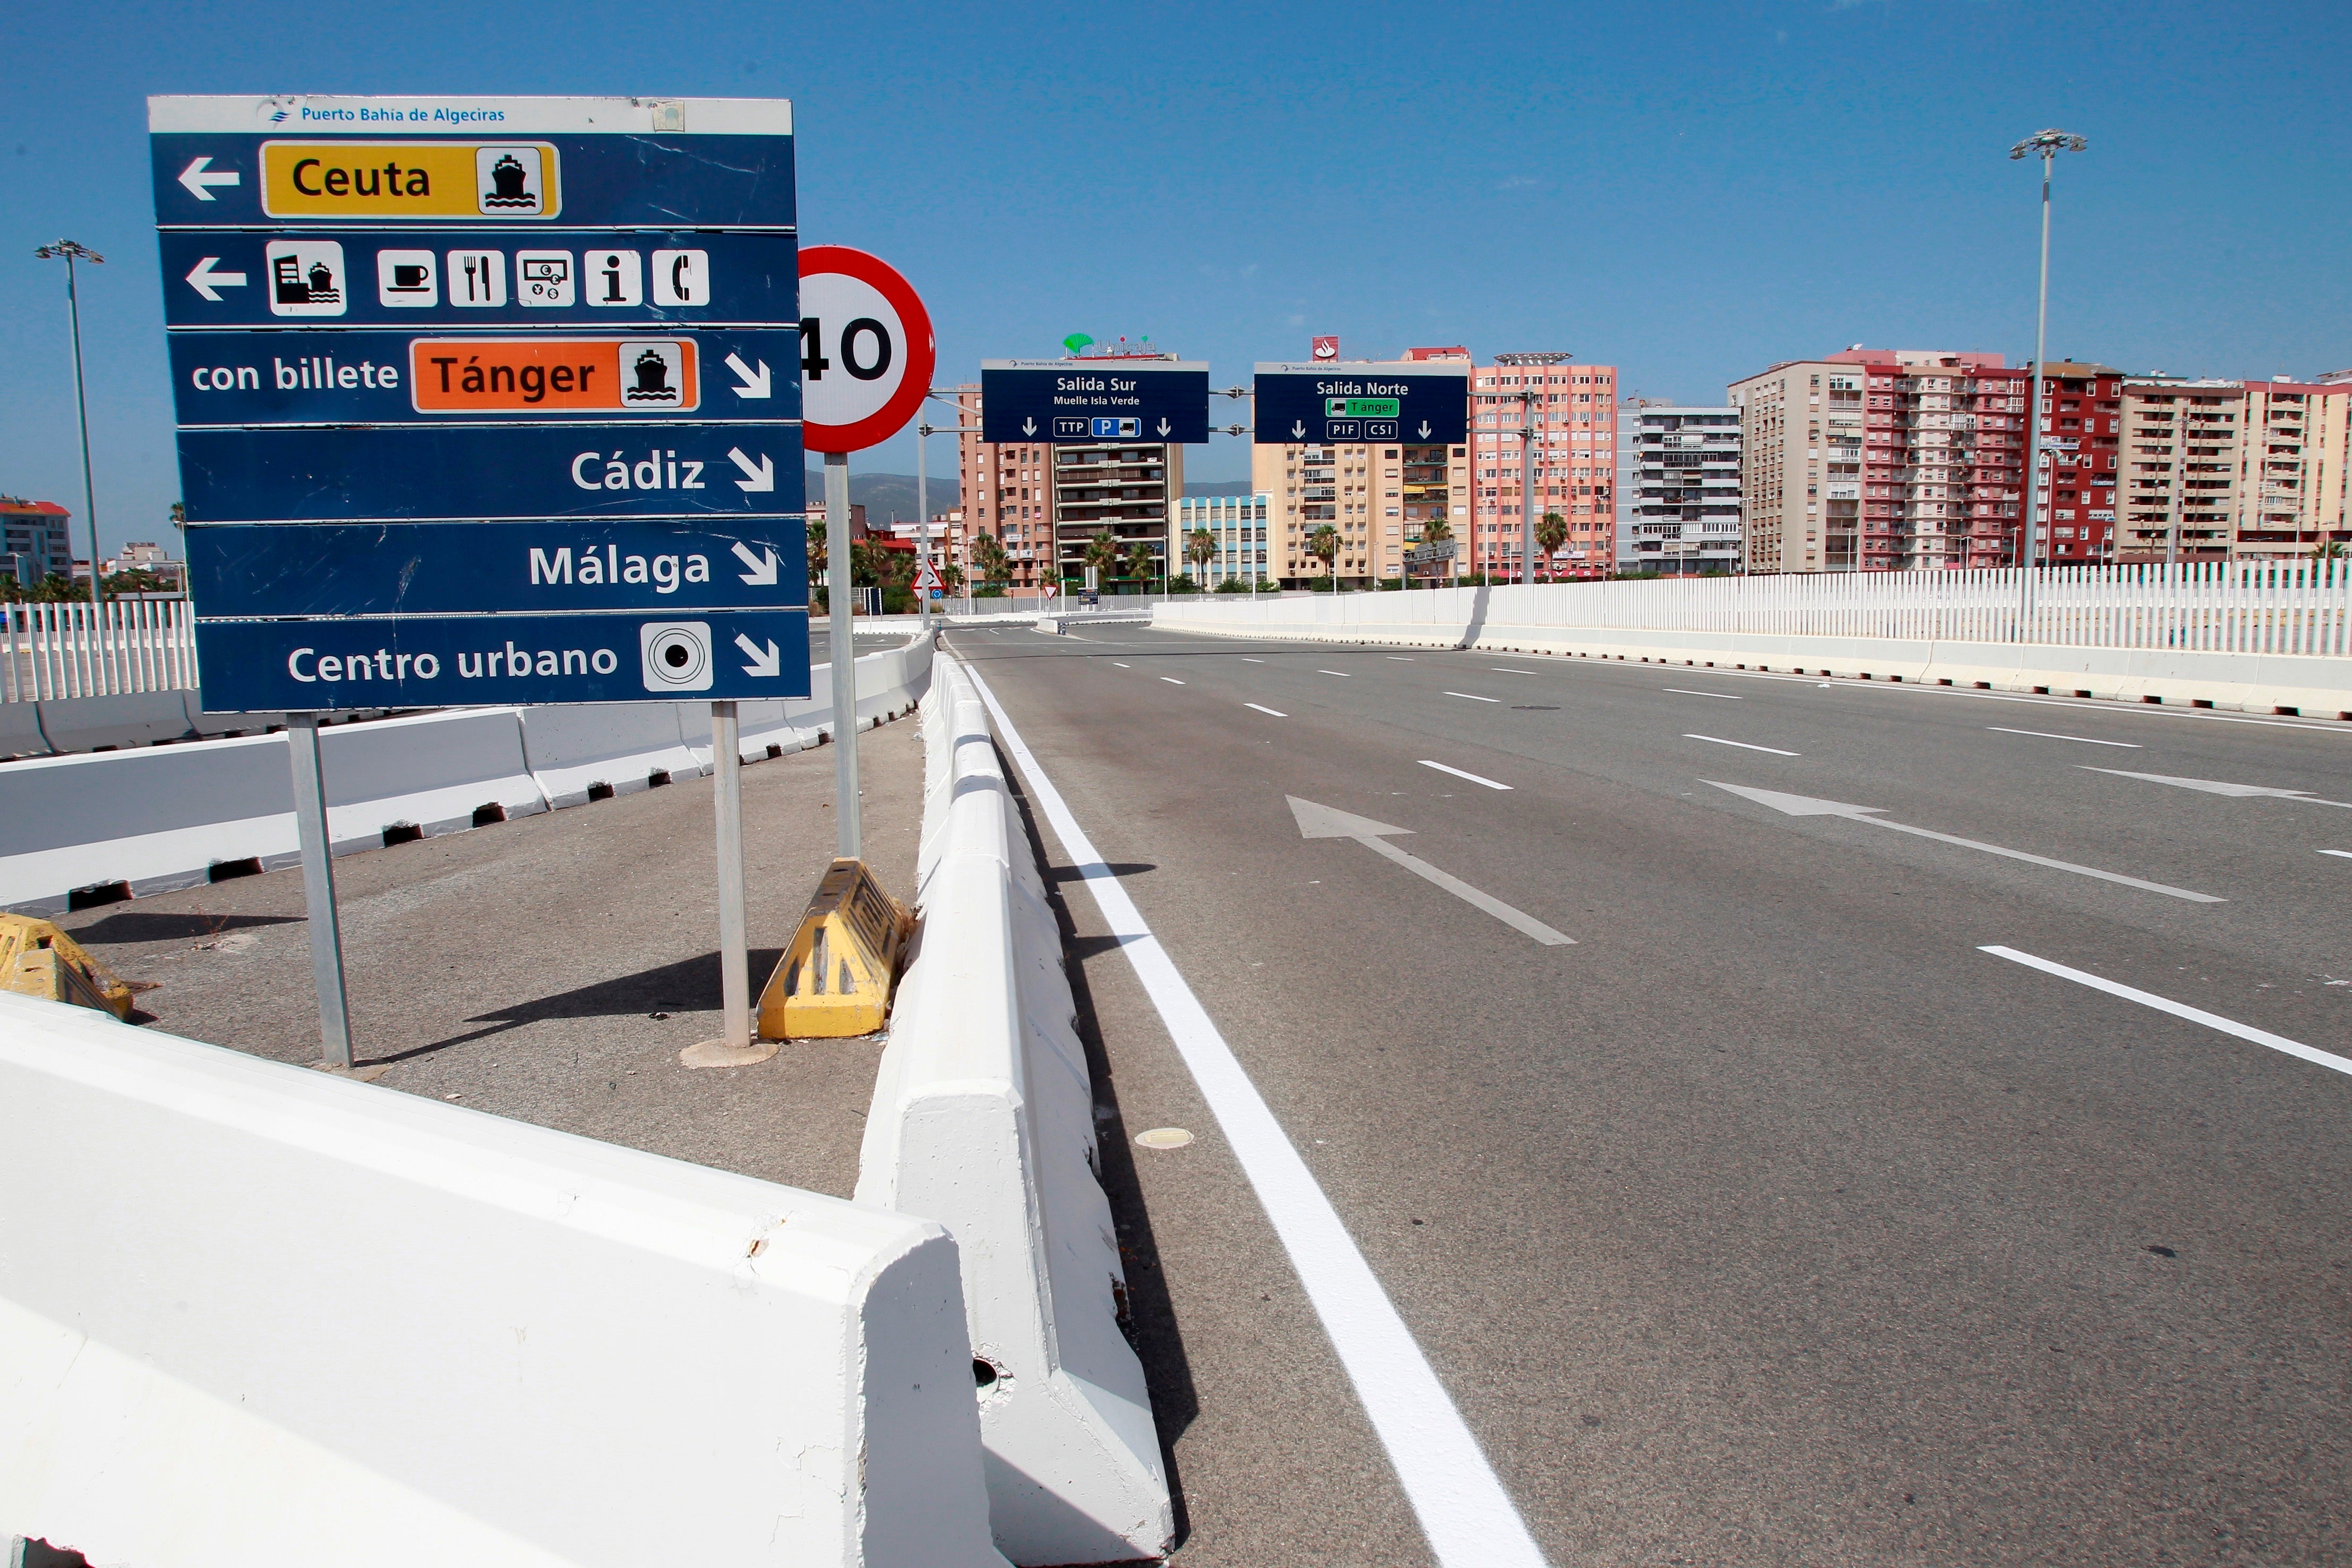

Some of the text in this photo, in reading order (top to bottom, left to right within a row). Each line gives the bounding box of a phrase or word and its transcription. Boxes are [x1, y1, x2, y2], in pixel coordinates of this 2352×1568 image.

[302, 108, 505, 124] Puerto Bahía de Algeciras
[293, 159, 431, 197] Ceuta
[800, 318, 892, 381] 40
[1097, 339, 1157, 355] Unicaja
[193, 356, 596, 402] con billete Tánger
[1057, 377, 1136, 391] Salida Sur
[1316, 381, 1408, 396] Salida Norte
[1054, 396, 1140, 405] Muelle Isla Verde
[1351, 401, 1393, 414] Tánger
[1059, 422, 1084, 433] TTP
[1333, 425, 1354, 434] PIF
[1370, 425, 1391, 434] CSI
[571, 449, 706, 491] Cádiz
[530, 544, 710, 594] Málaga
[288, 641, 618, 683] Centro urbano
